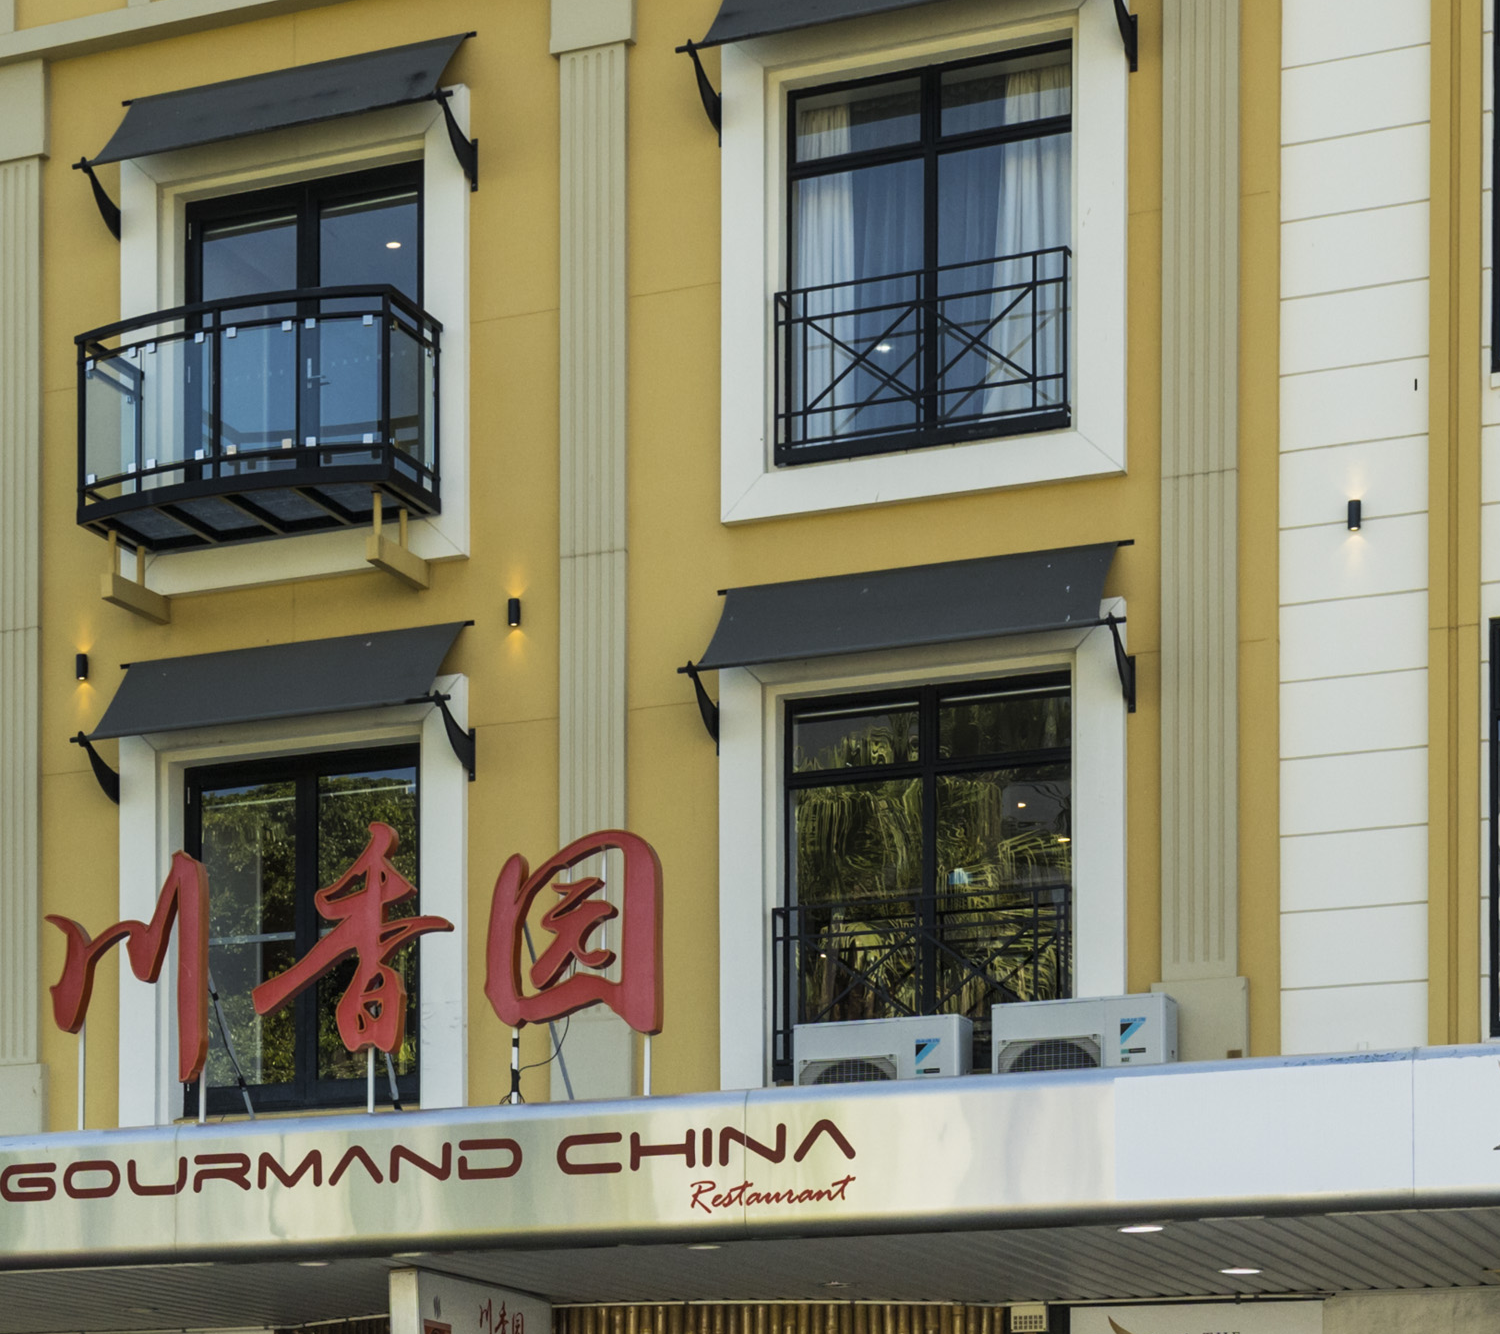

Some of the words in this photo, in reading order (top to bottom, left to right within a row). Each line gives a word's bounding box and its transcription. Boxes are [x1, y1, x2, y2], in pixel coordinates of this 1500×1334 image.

[45, 822, 664, 1084] 川香园
[0, 1137, 523, 1202] GOURMAND
[556, 1119, 857, 1175] CHINA
[689, 1174, 857, 1214] Restaurant
